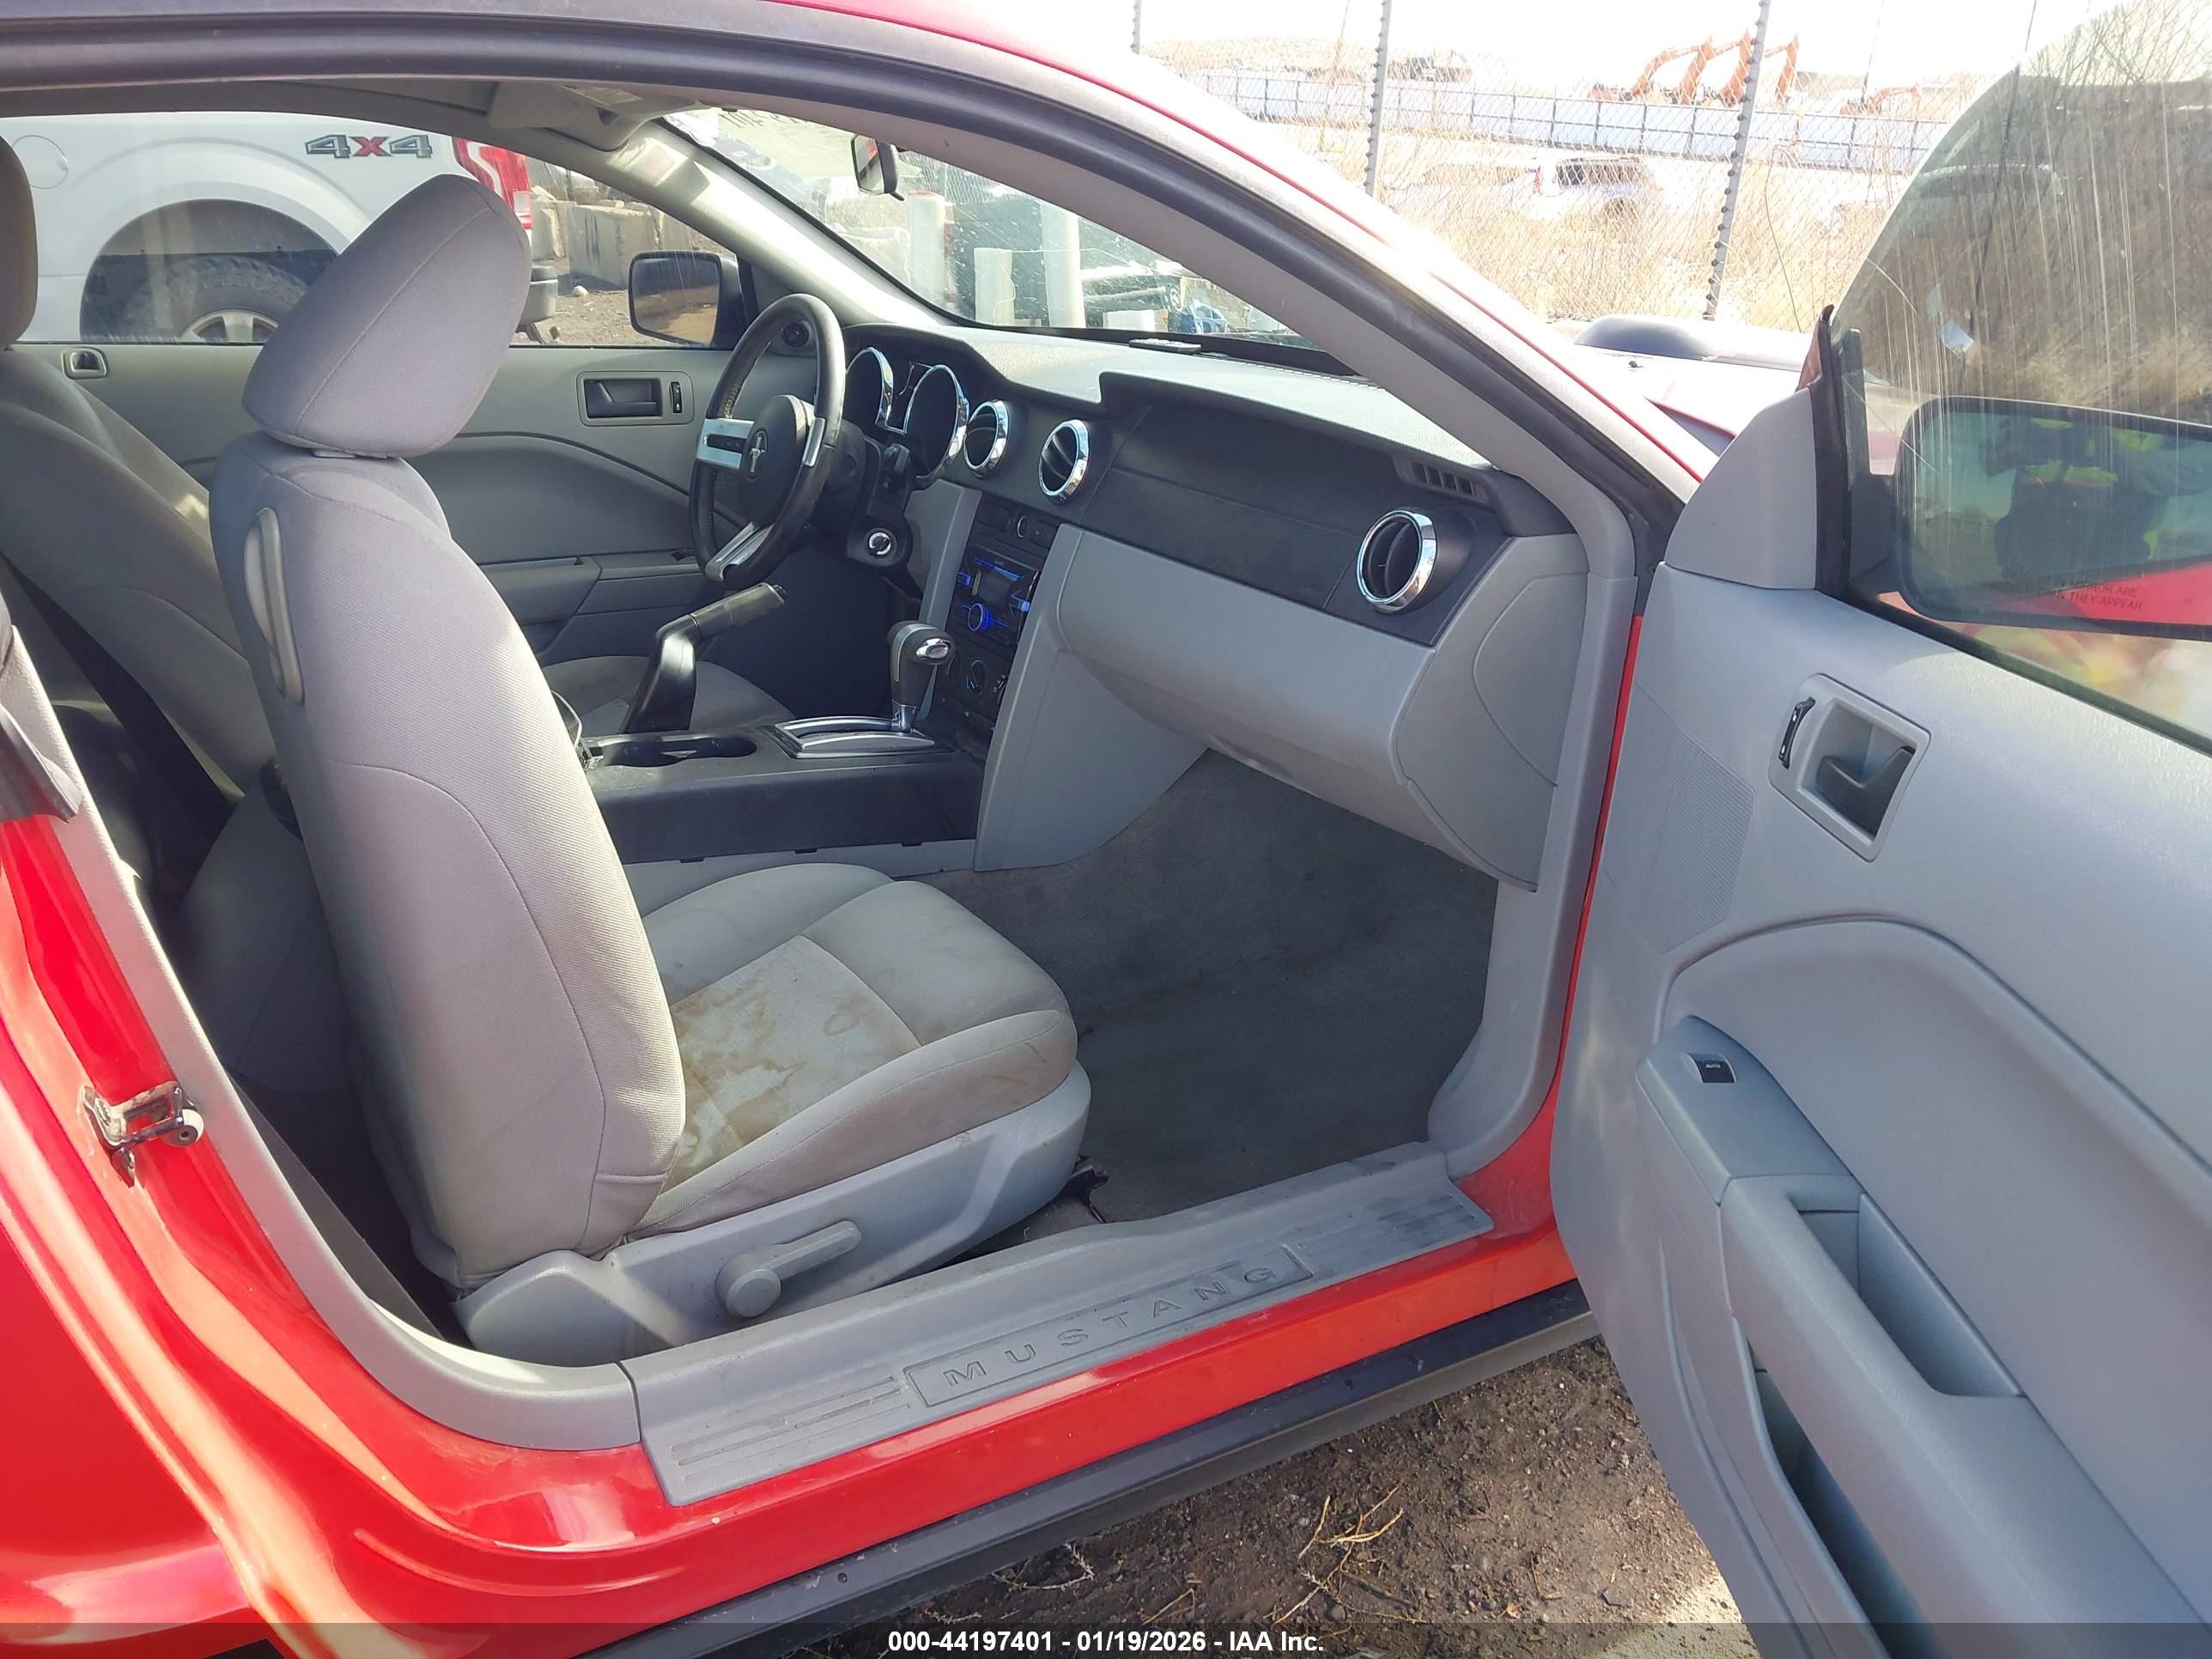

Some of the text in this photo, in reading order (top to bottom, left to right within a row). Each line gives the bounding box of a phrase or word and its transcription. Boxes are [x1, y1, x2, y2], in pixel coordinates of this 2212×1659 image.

[2069, 591, 2143, 611] THEY APPEAR
[2116, 586, 2137, 598] ARE
[942, 1266, 1278, 1387] MUSTANG
